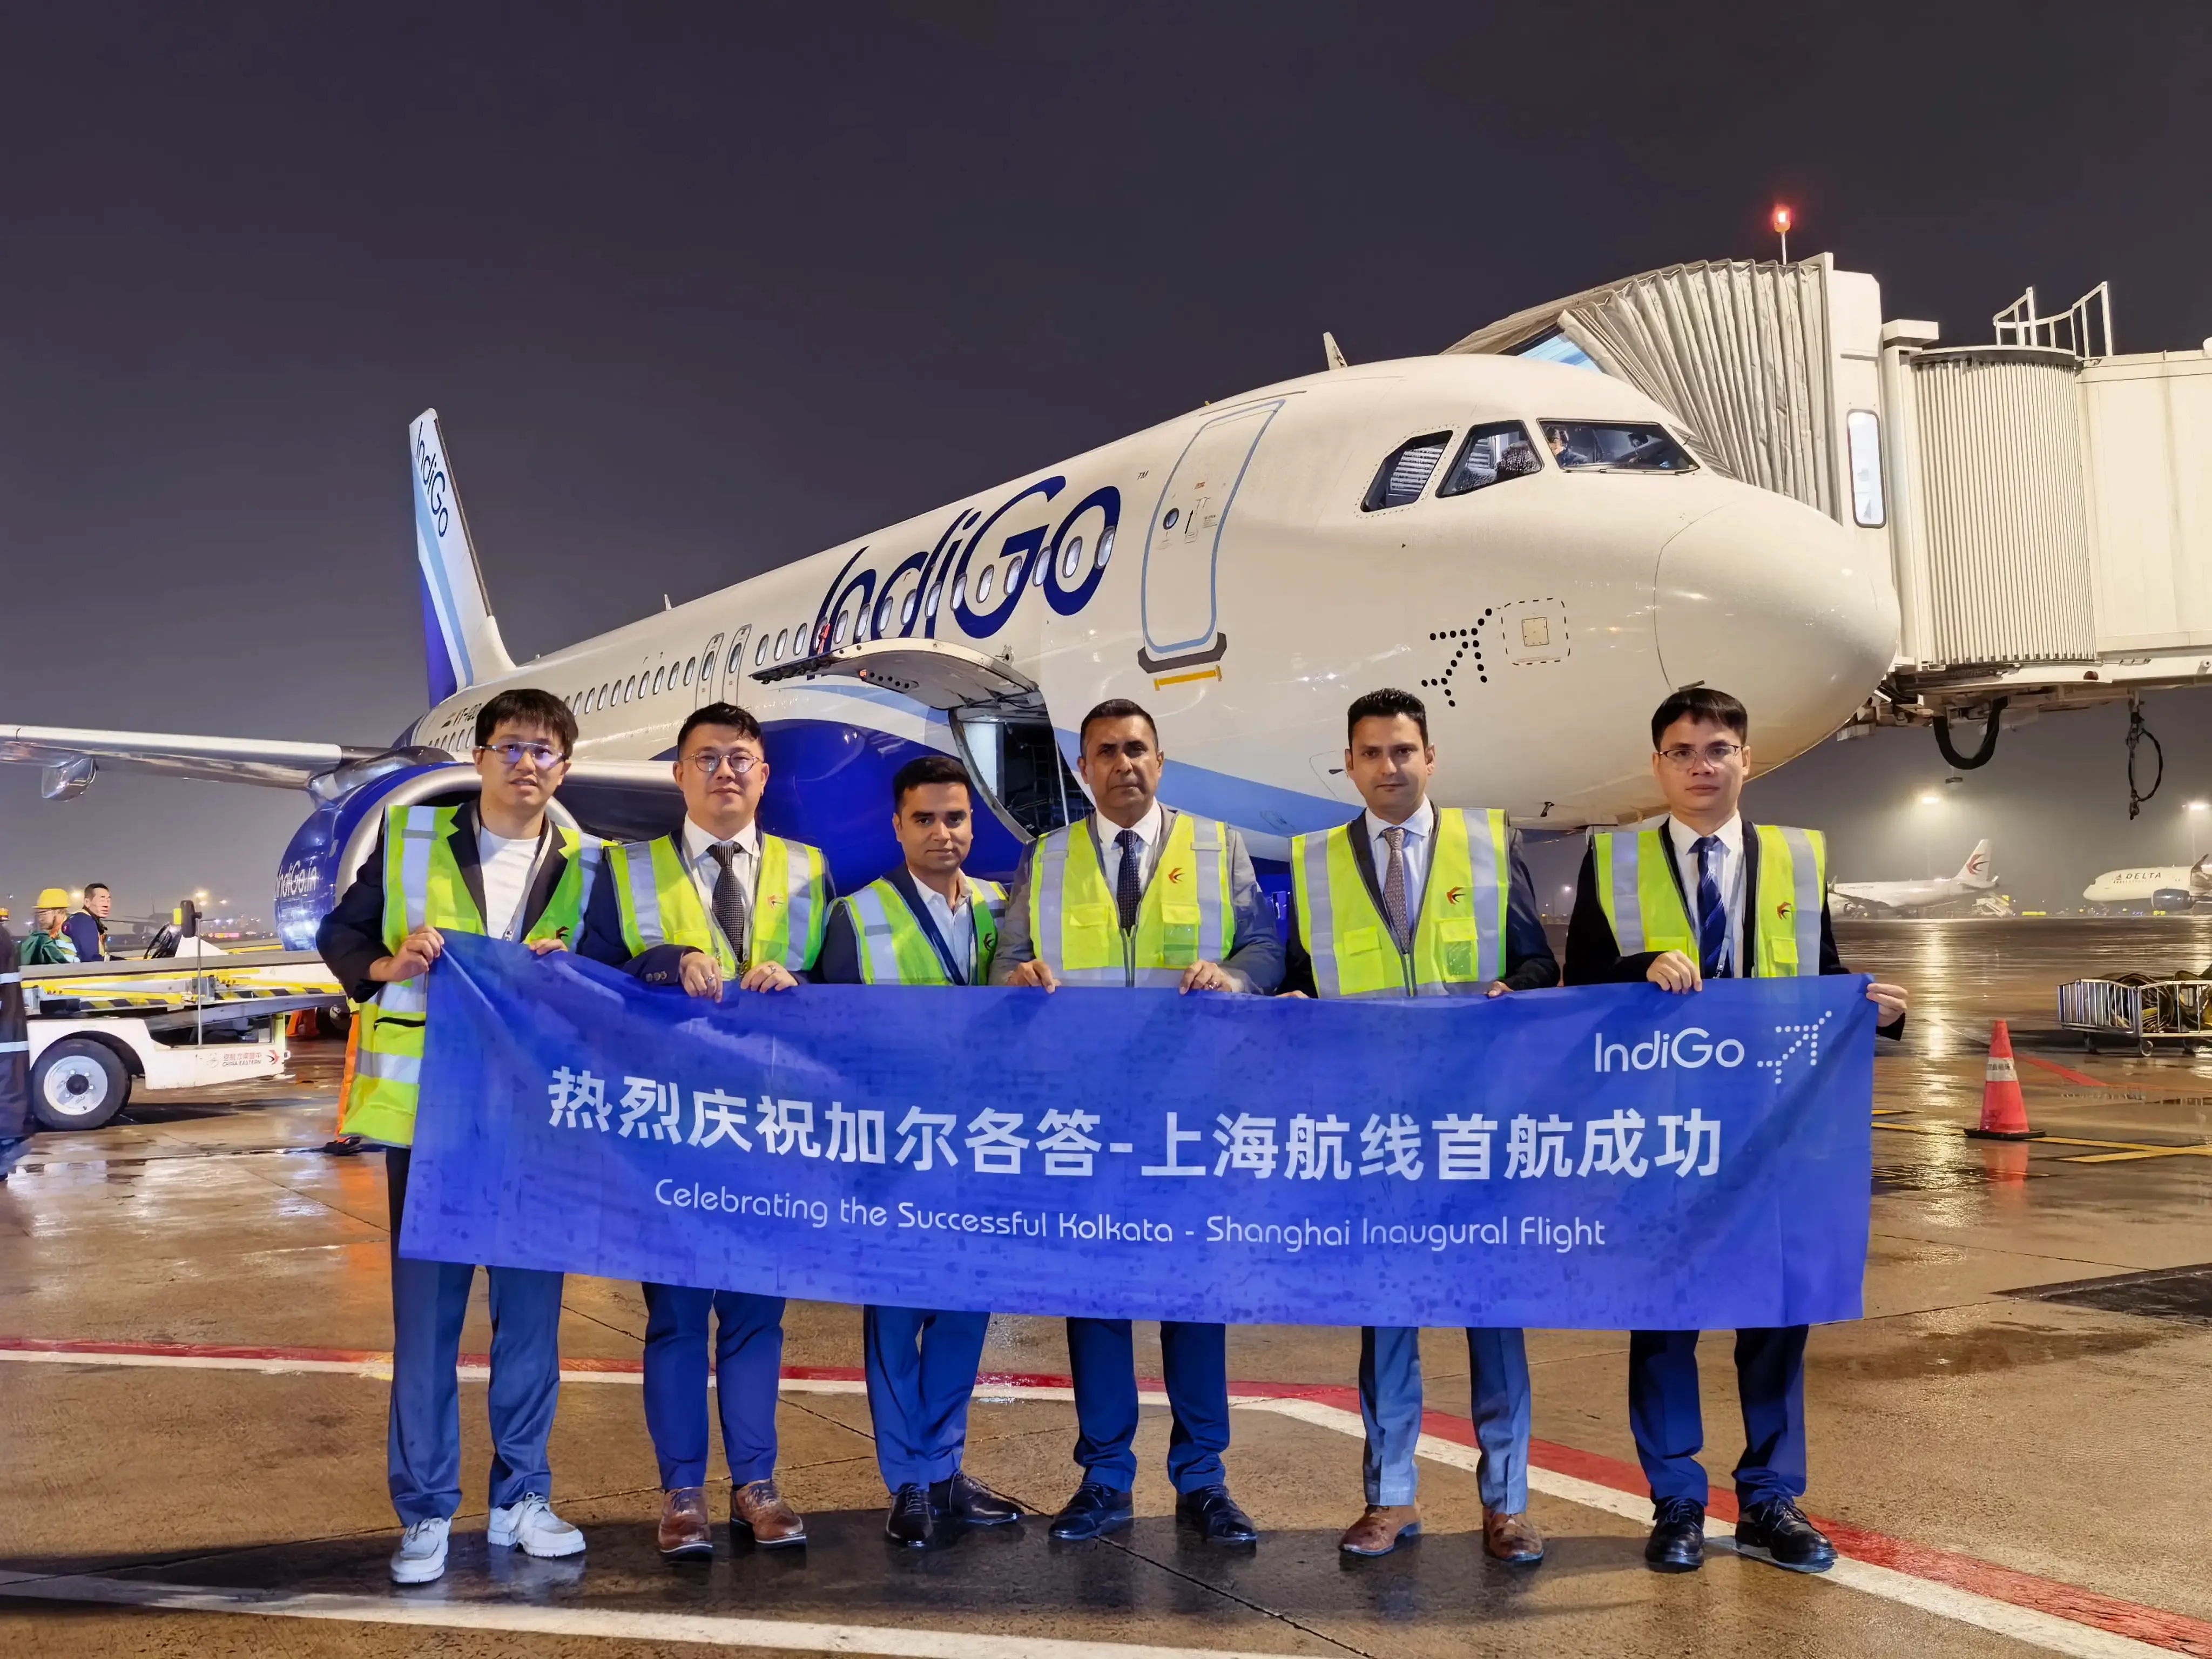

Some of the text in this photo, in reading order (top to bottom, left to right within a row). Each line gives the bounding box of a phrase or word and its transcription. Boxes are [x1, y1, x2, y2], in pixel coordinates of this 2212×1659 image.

[416, 420, 448, 537] IndiGo
[807, 475, 1121, 675] IndiGo
[1596, 1027, 1745, 1072] IndiGo
[549, 1067, 1721, 1181] 热烈庆祝加尔各答-上海航线首航成功
[656, 1179, 827, 1228] Celebrating
[840, 1197, 887, 1226] the
[898, 1202, 1046, 1236] Successful
[1060, 1213, 1172, 1242] Kolkata
[1206, 1216, 1349, 1252] Shanghai
[1363, 1216, 1507, 1251] Inaugural
[1521, 1217, 1605, 1253] Flight
